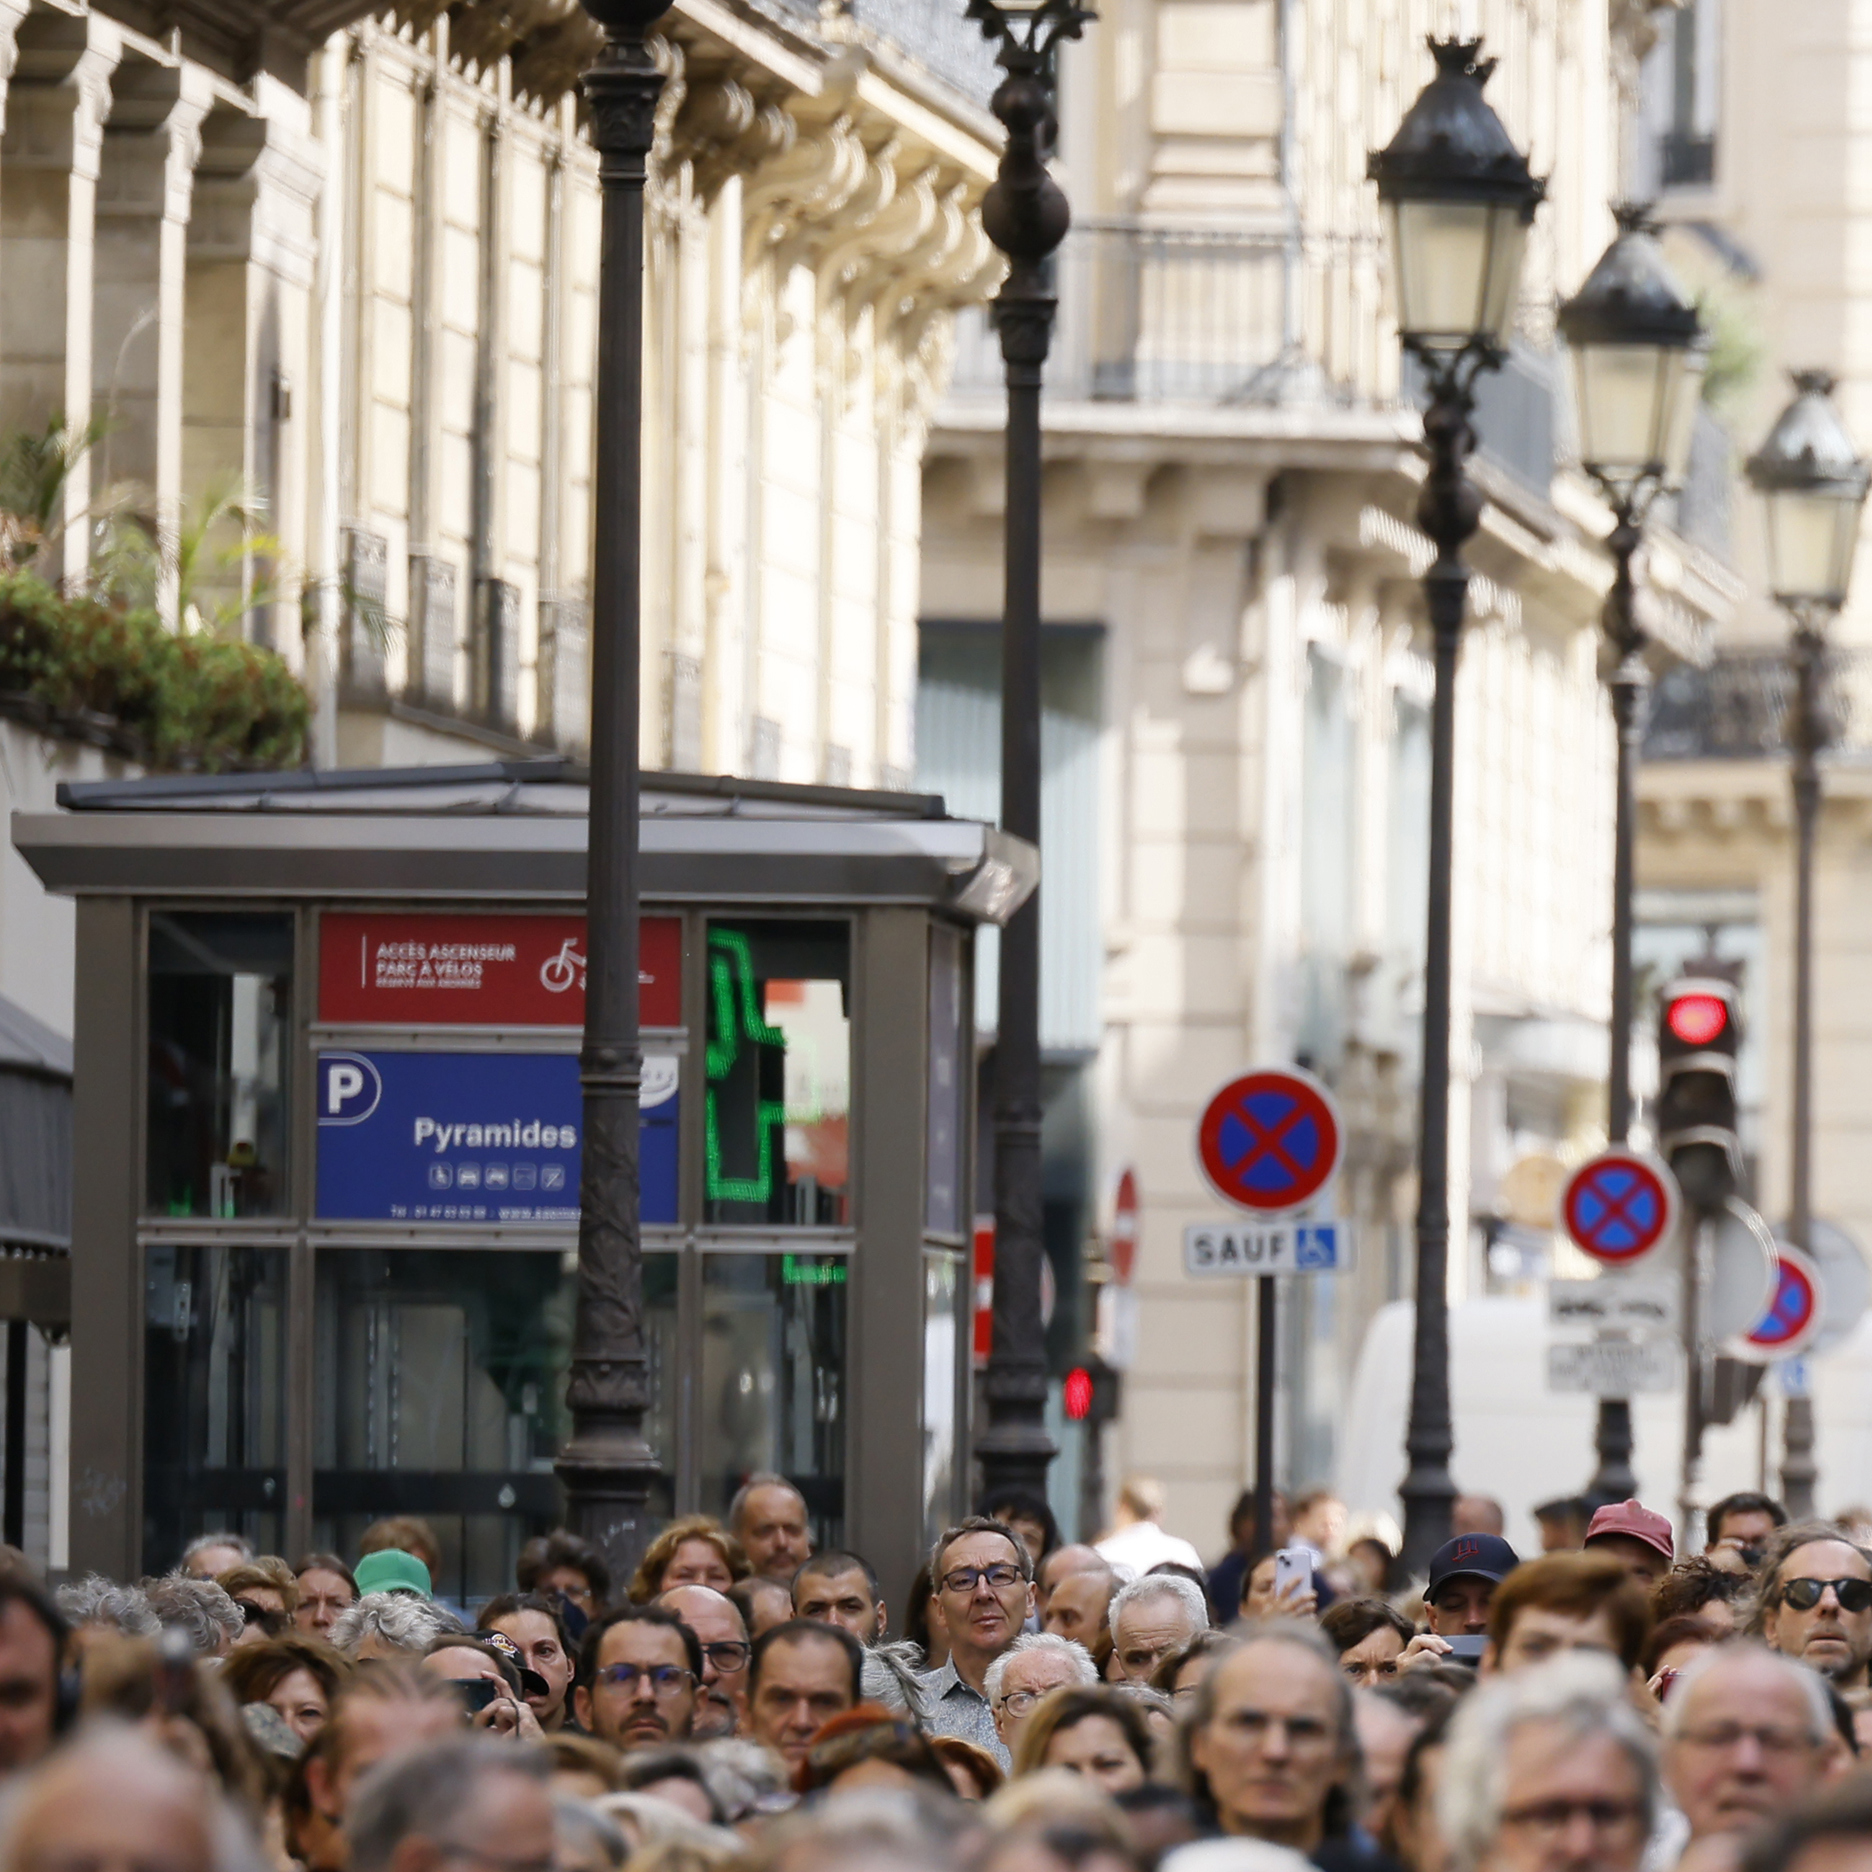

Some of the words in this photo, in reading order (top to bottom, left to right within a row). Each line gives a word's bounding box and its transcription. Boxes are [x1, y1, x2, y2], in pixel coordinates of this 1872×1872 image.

[376, 938, 426, 960] ACCÈS
[429, 942, 516, 962] ASCENSEUR
[376, 960, 417, 978] PARC
[328, 1063, 364, 1114] P
[414, 1116, 578, 1154] Pyramides
[1194, 1232, 1286, 1266] SAUF
